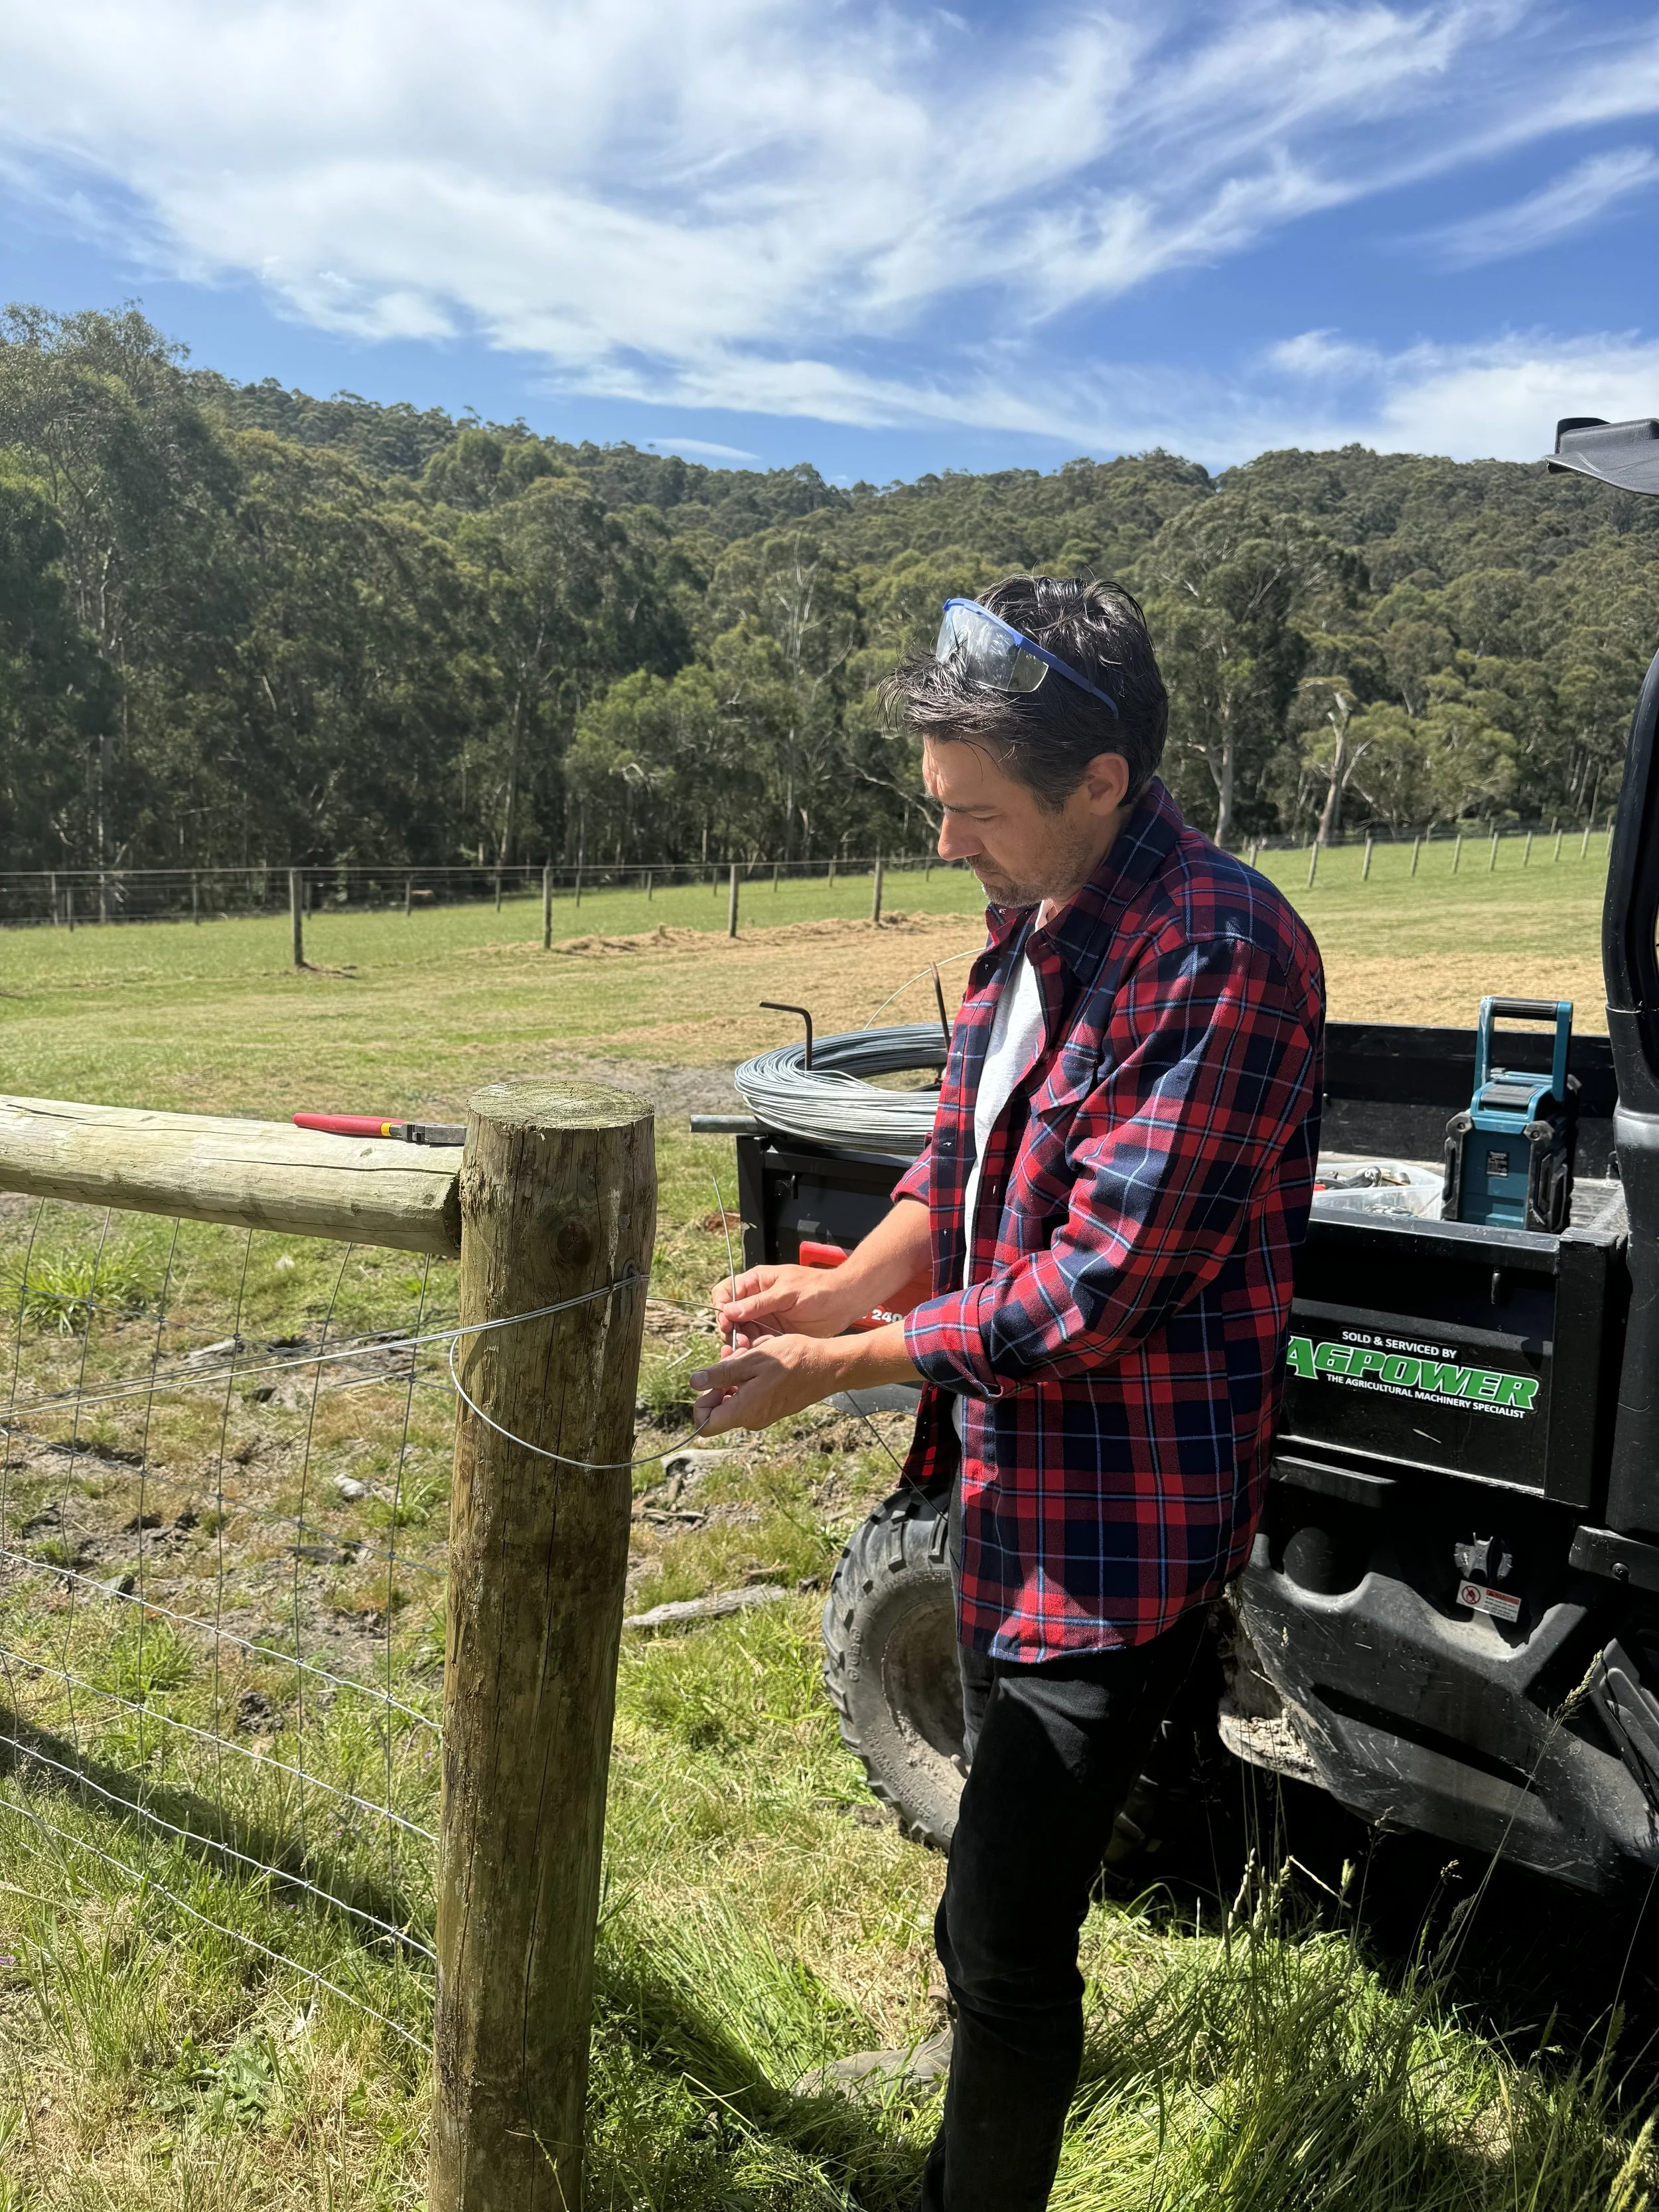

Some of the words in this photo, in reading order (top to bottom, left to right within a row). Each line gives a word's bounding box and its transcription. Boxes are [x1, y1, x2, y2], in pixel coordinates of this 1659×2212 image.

[1342, 1331, 1371, 1344] SOLD
[1373, 1336, 1383, 1347] &
[1385, 1338, 1439, 1356] SERVICED
[1442, 1348, 1457, 1359] BY
[1287, 1335, 1540, 1410] AGPOWER
[1326, 1373, 1344, 1384] THE
[1345, 1377, 1413, 1398] AGRICULTURAL
[1414, 1390, 1472, 1408] MACHINERY
[1473, 1401, 1526, 1419] SPECIALIST
